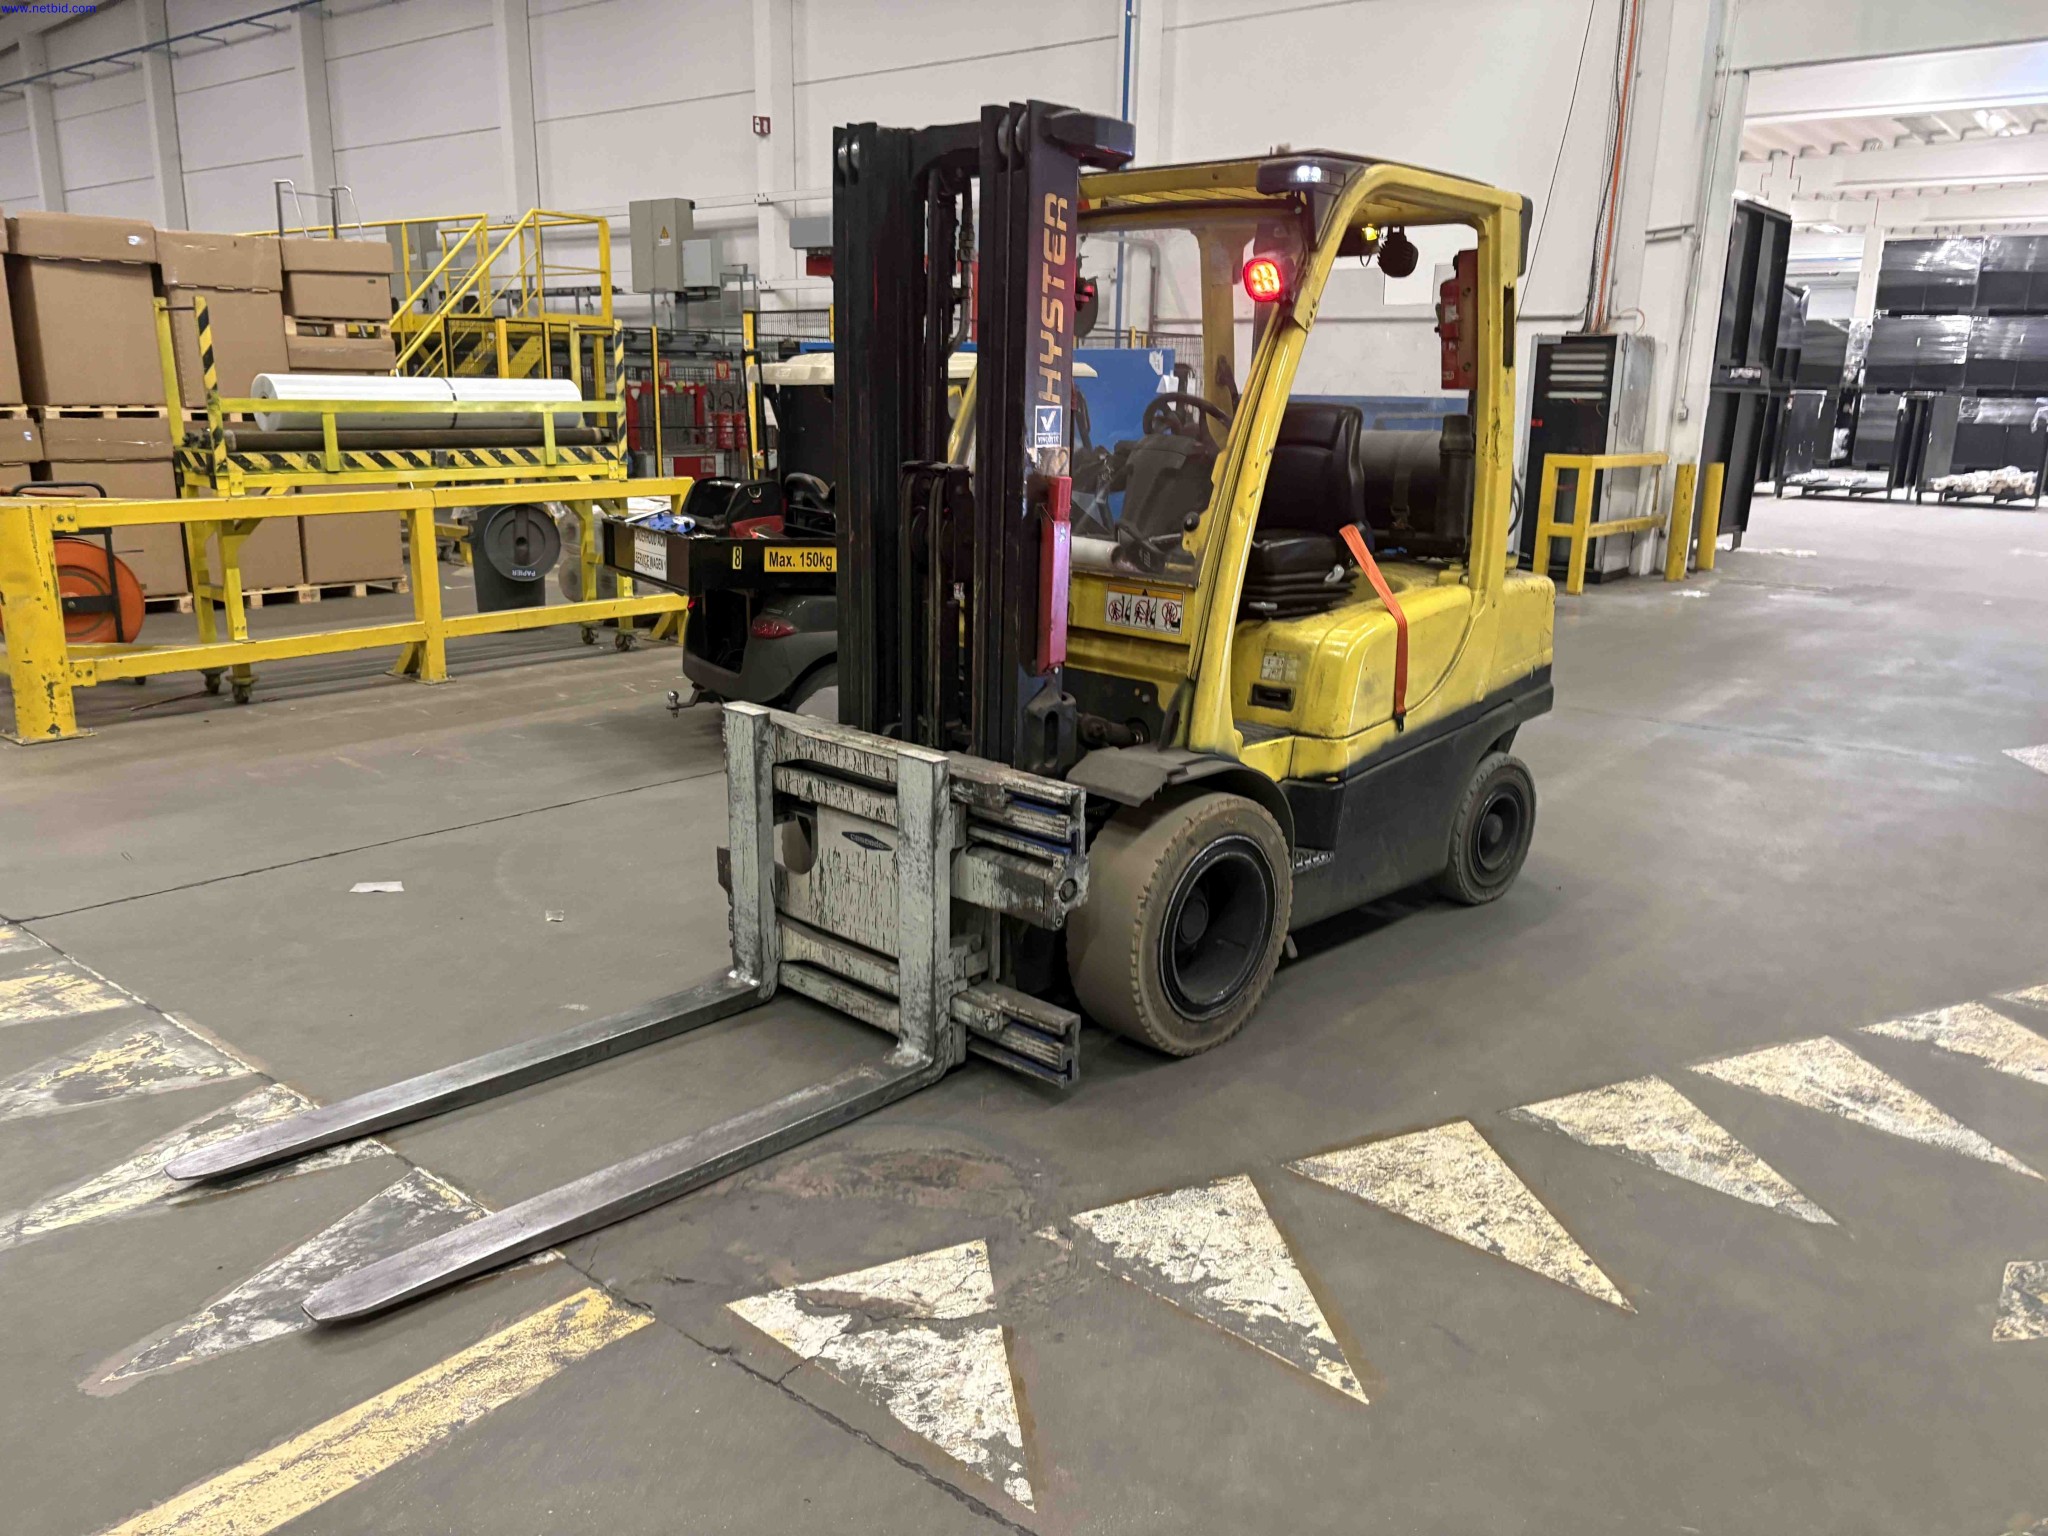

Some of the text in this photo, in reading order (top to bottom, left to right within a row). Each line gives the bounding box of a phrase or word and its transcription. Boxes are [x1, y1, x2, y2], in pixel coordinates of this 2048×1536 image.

[1038, 192, 1068, 404] HYSTER
[635, 550, 650, 570] SERVICE
[734, 547, 741, 568] 8
[769, 551, 833, 571] Max. 150kg
